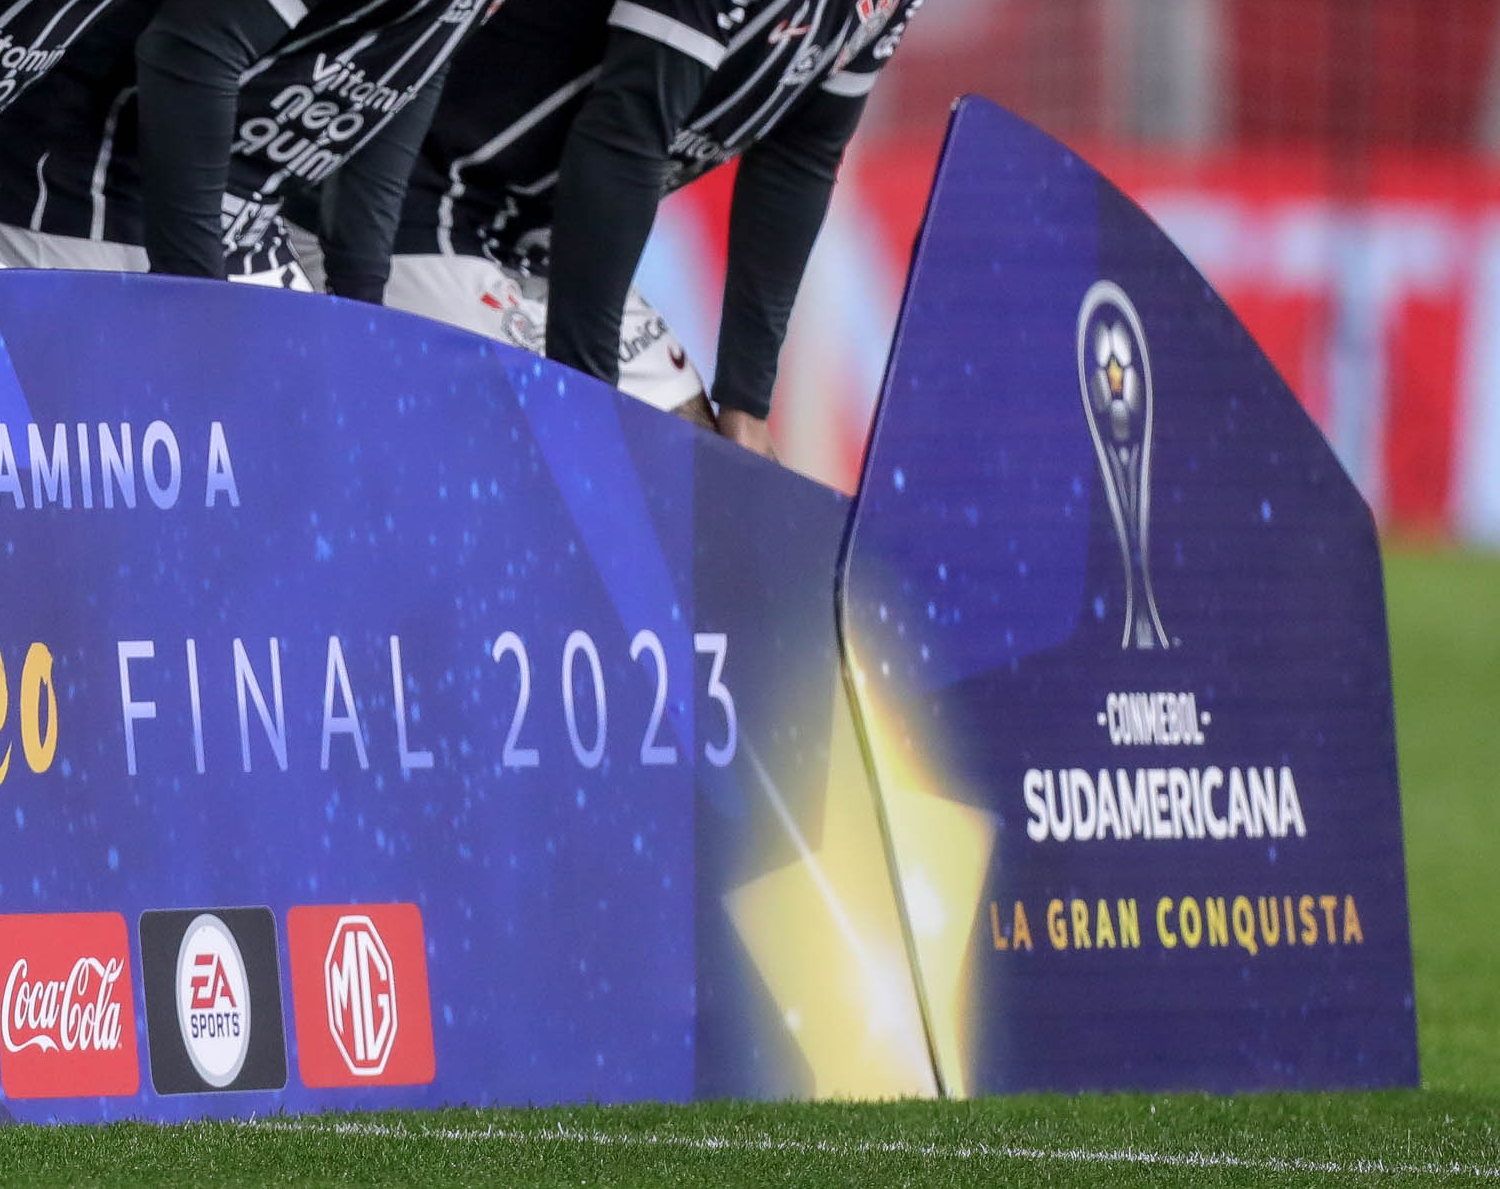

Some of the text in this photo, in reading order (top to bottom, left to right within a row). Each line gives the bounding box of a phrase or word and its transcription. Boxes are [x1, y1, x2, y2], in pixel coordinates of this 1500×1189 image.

[270, 84, 365, 142] neo
[204, 420, 242, 509] A
[116, 628, 738, 777] FINAL 2023
[1023, 766, 1307, 842] SUDAMERICANA
[989, 893, 1365, 957] LA GRAN CONQUISTA
[190, 953, 236, 1010] EA
[331, 928, 393, 1061] MG
[190, 1011, 239, 1040] SPORTS
